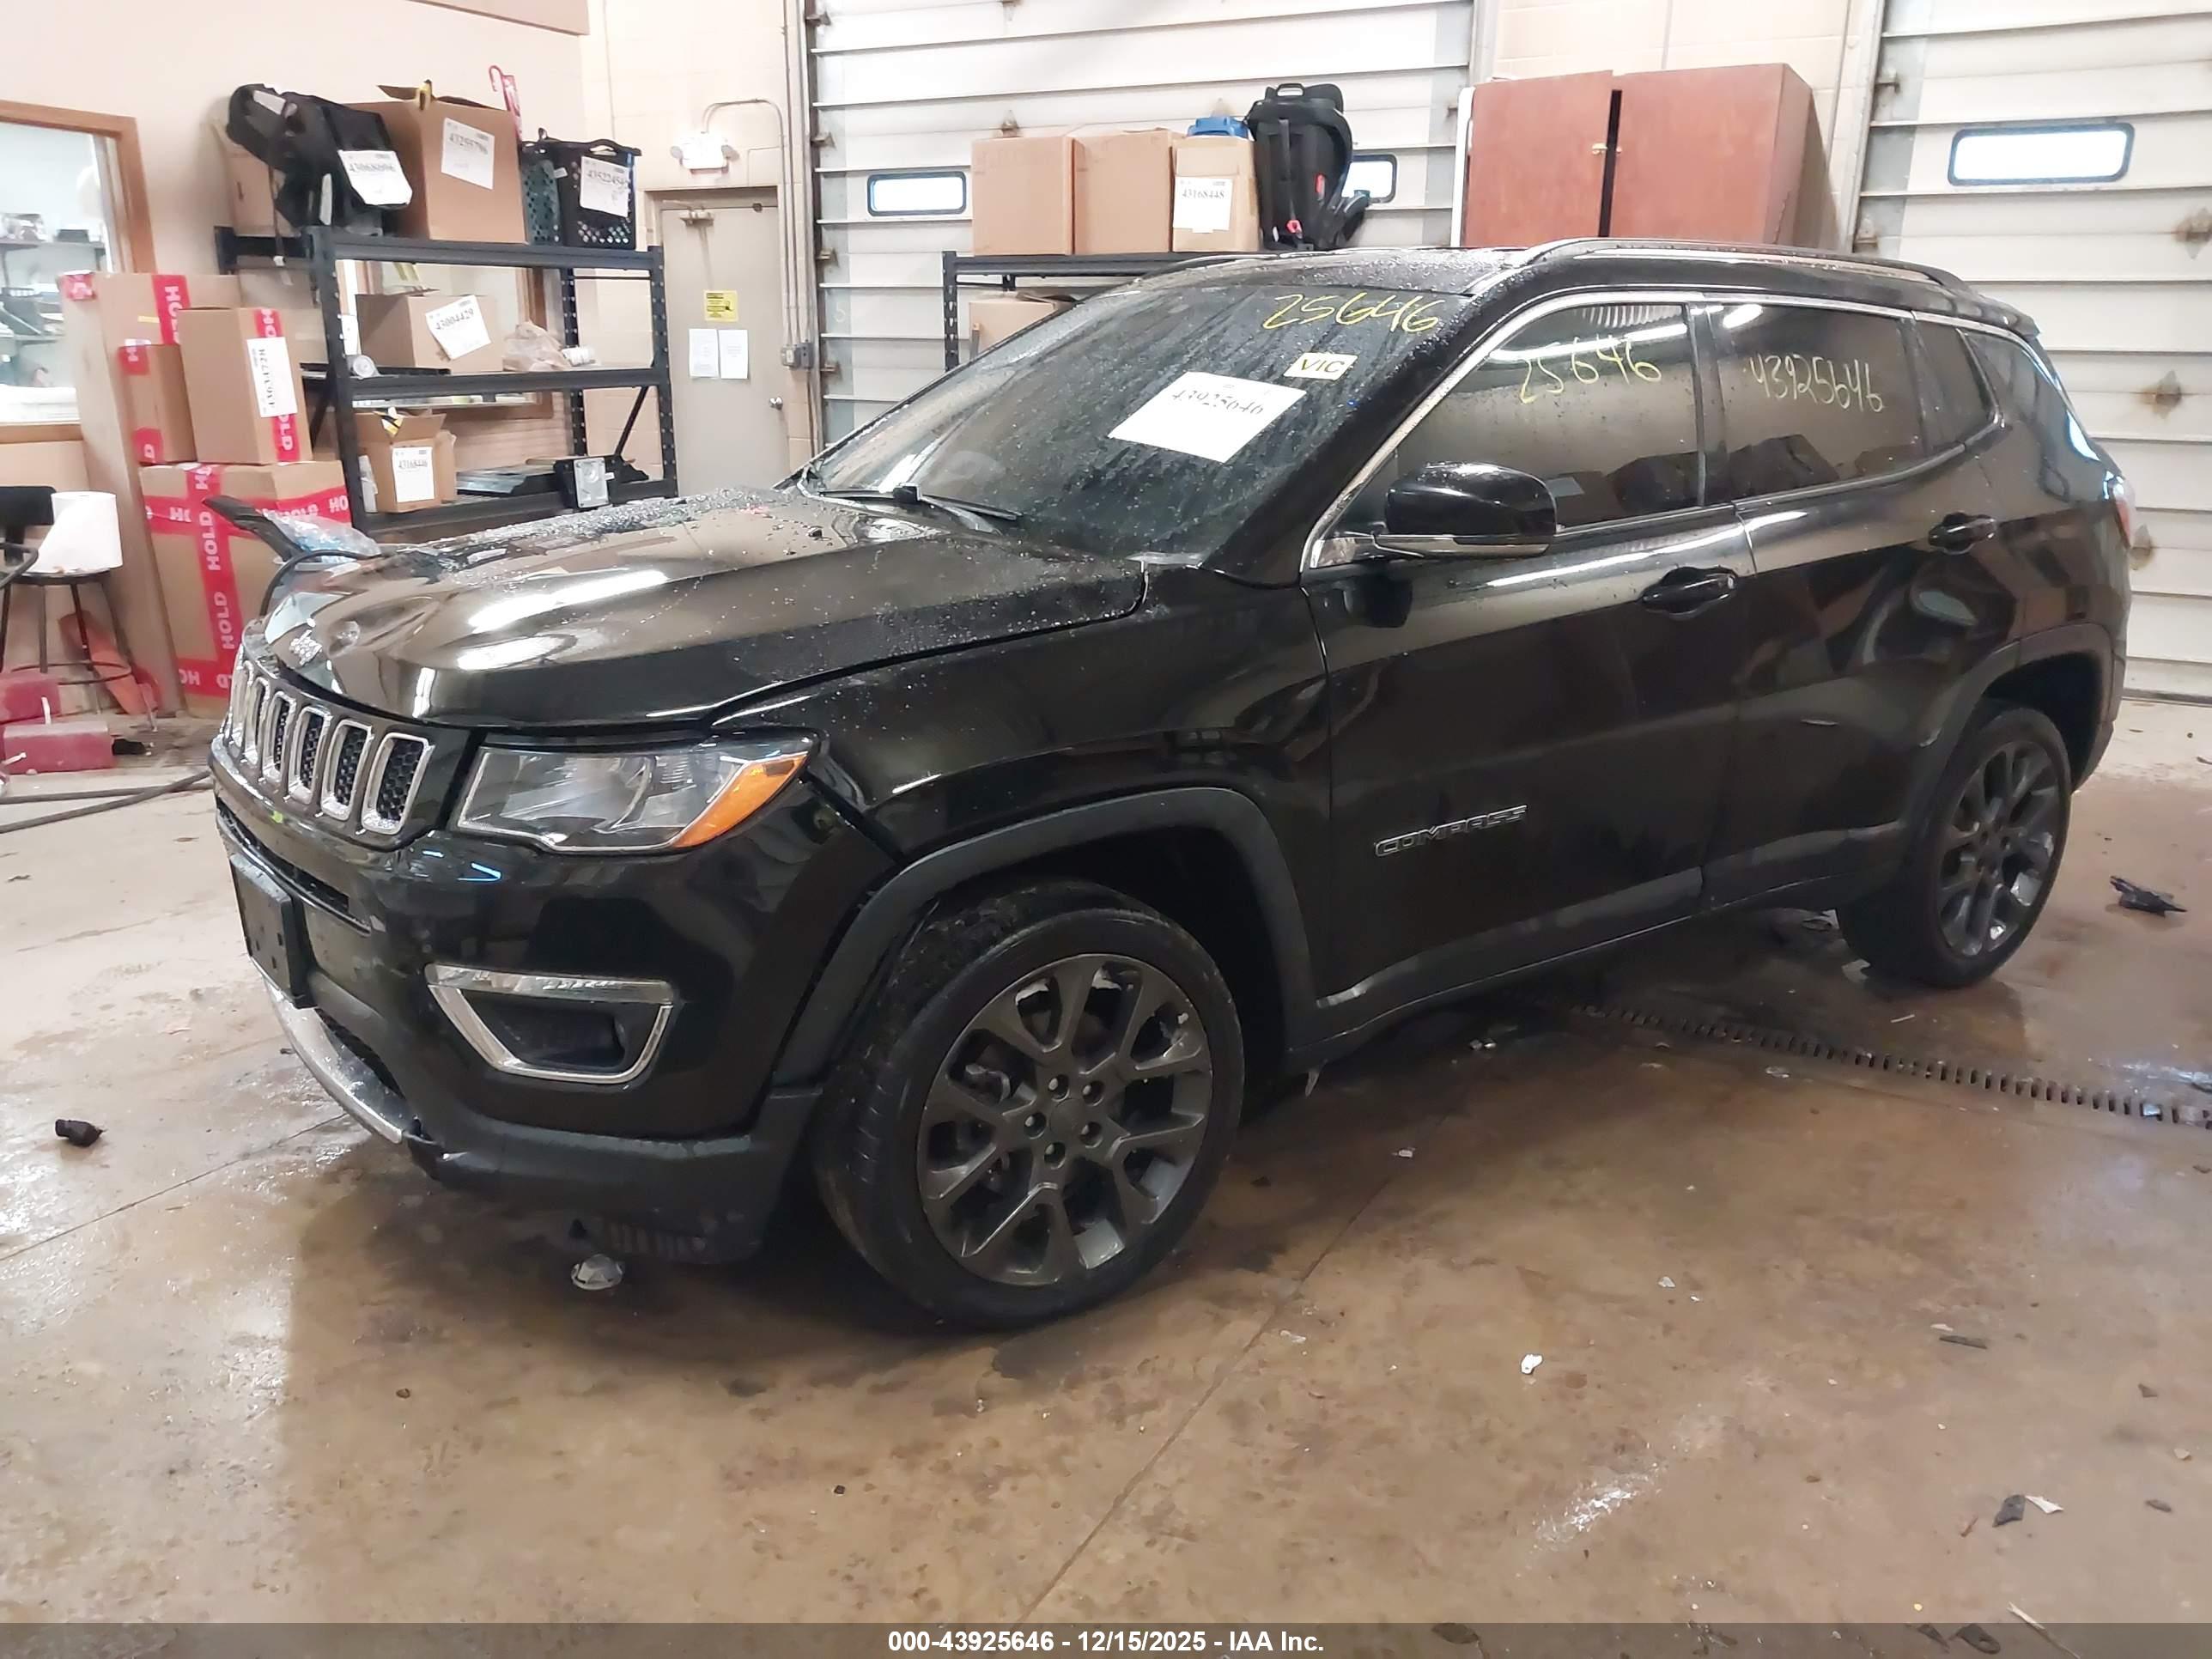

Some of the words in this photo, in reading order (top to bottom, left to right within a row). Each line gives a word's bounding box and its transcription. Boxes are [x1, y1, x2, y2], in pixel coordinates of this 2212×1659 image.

[1182, 188, 1225, 199] 43168448
[1262, 292, 1445, 333] 25646
[1300, 357, 1346, 374] VIC
[1519, 333, 1662, 404] 25646
[1749, 352, 1885, 412] 43925646
[198, 511, 221, 571] HOLD
[214, 592, 235, 650] HOLD
[1374, 805, 1528, 857] COMPASS
